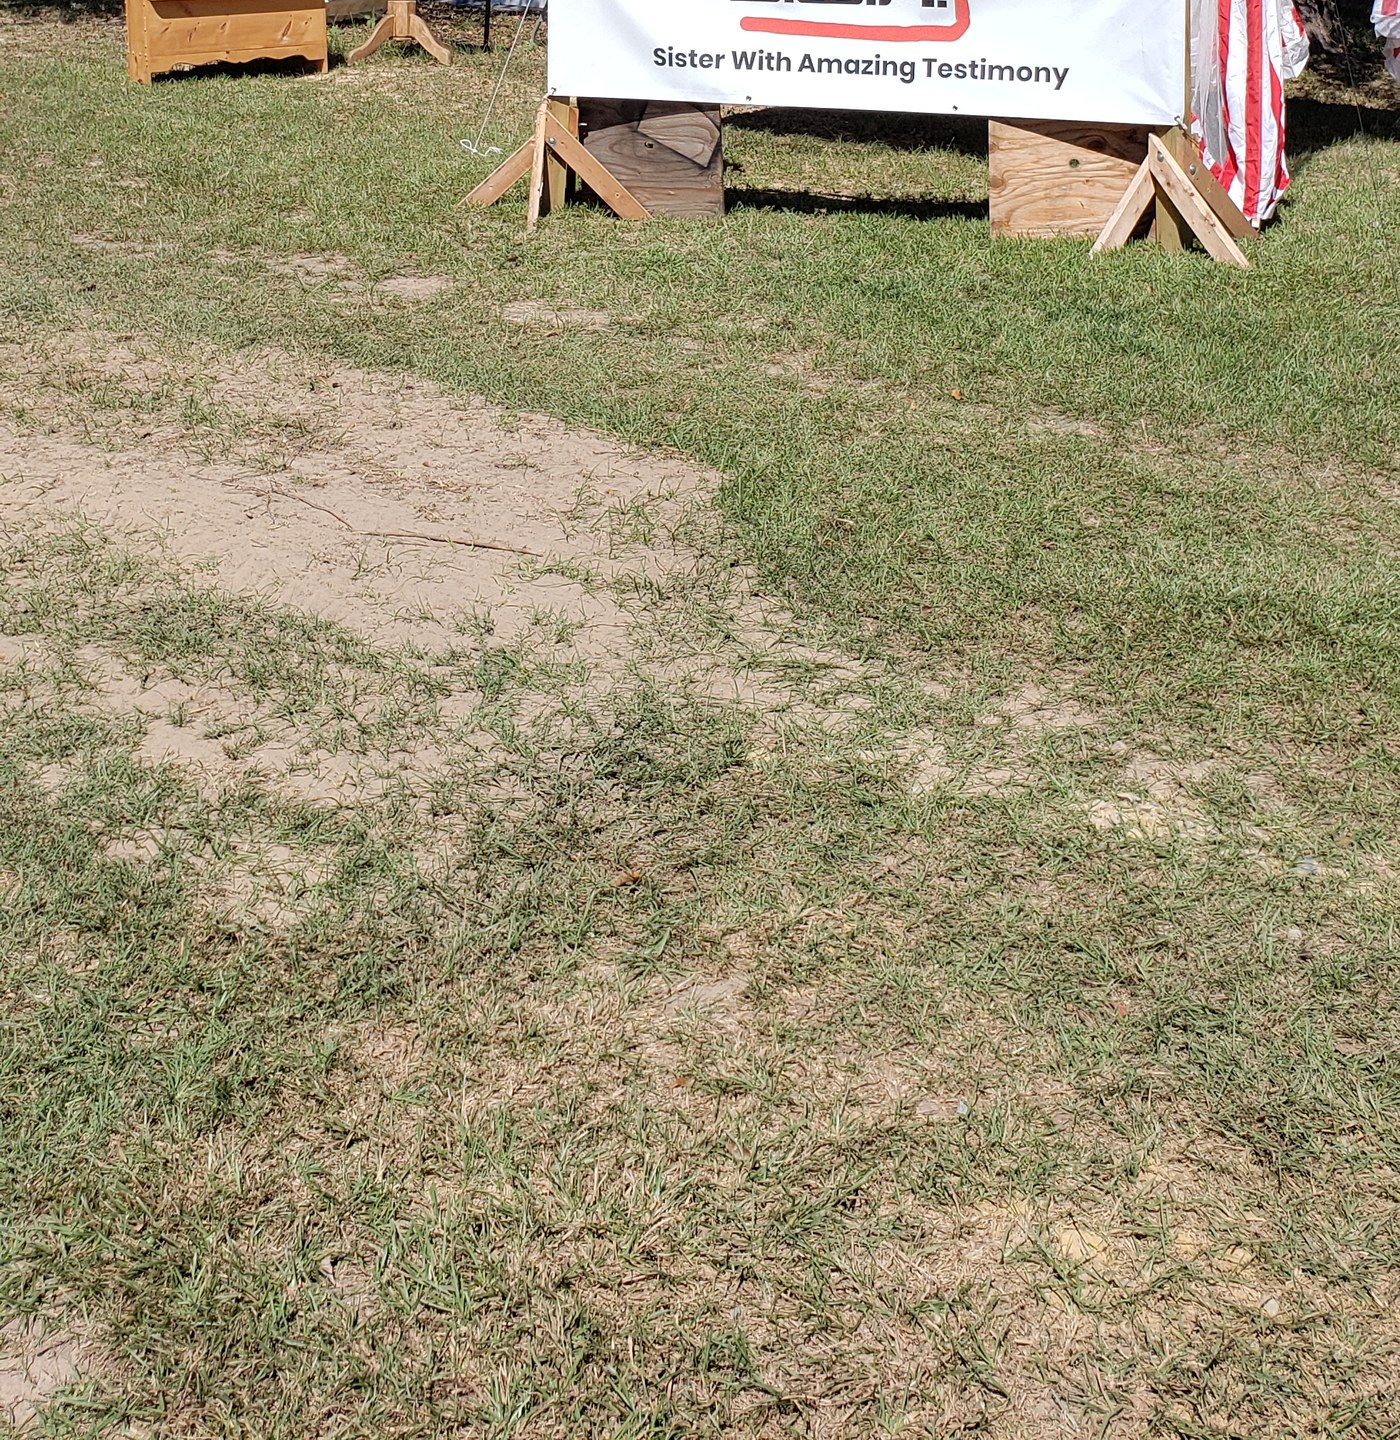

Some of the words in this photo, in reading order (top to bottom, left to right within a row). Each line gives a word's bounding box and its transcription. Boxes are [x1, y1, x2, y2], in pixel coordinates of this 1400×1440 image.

[652, 46, 727, 70] Sister
[731, 49, 792, 73] With
[797, 53, 917, 85] Amazing
[922, 58, 1071, 91] Testimony
